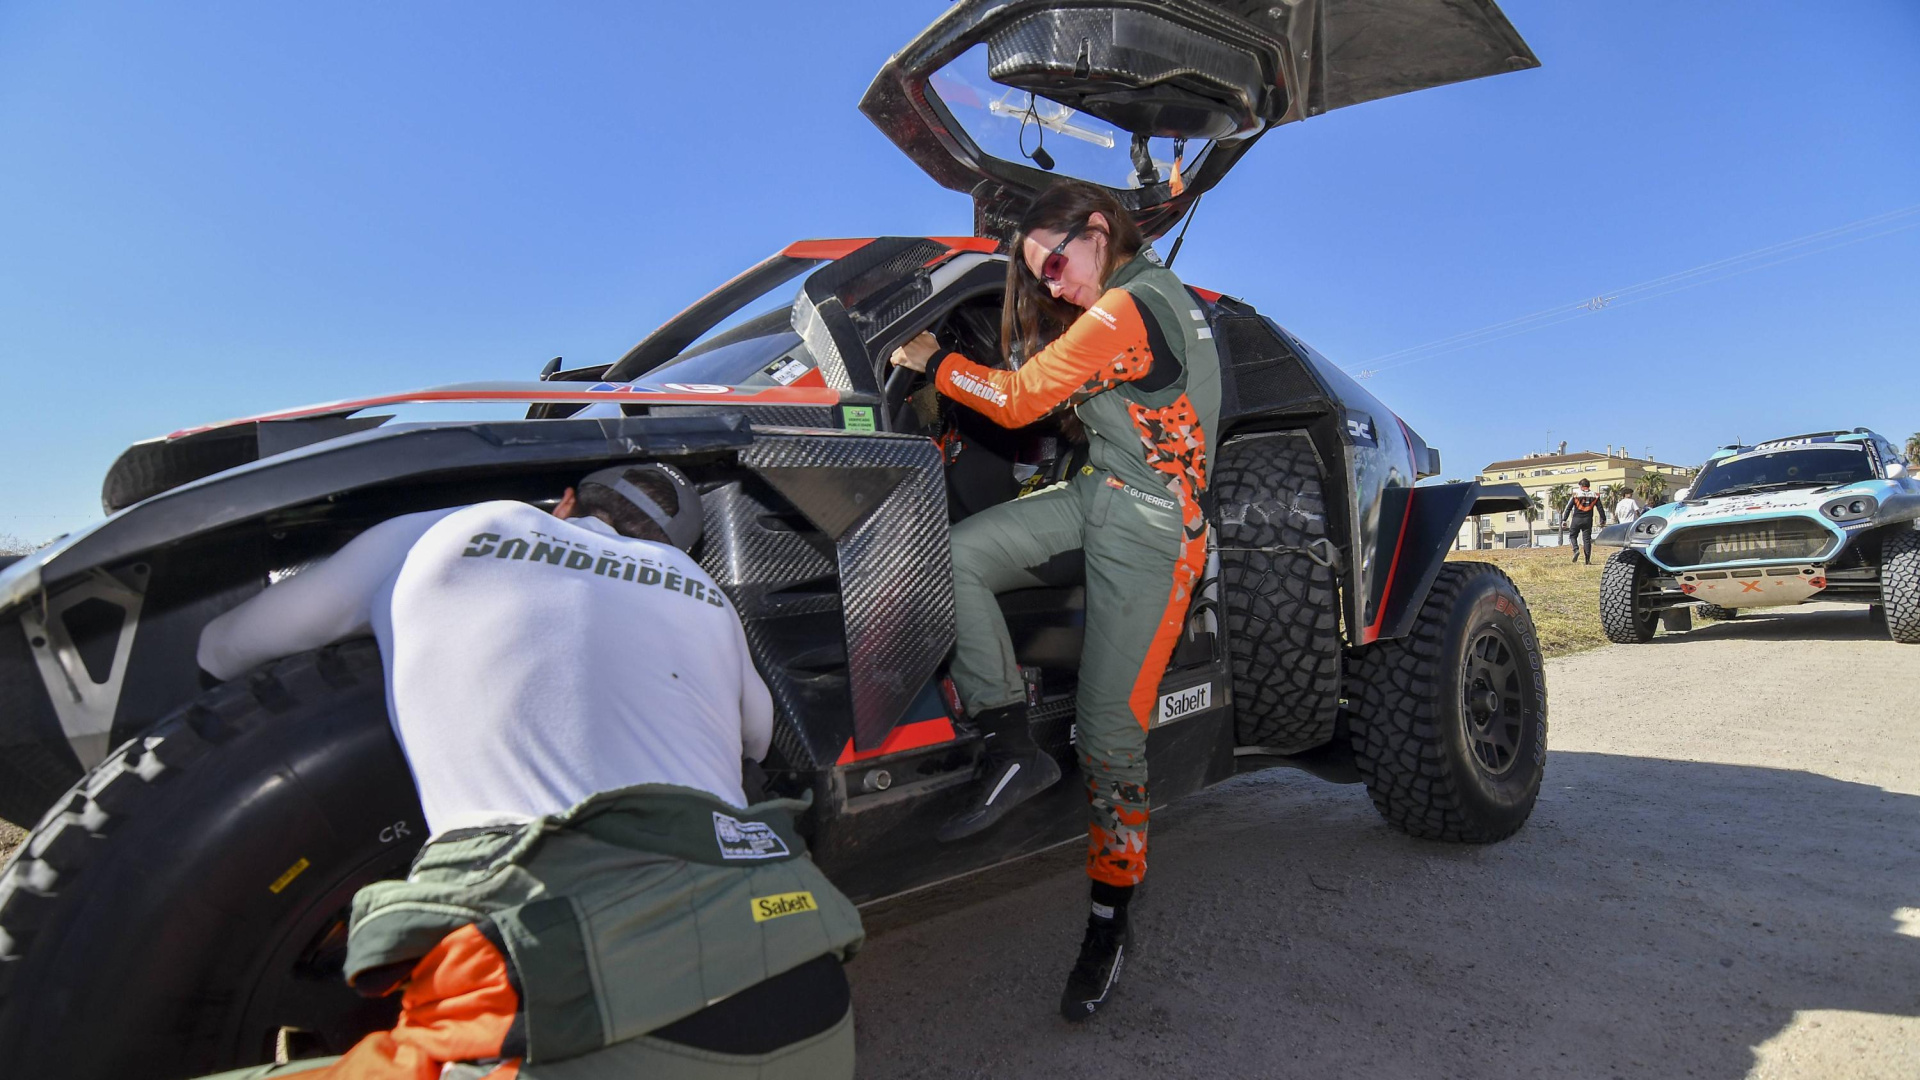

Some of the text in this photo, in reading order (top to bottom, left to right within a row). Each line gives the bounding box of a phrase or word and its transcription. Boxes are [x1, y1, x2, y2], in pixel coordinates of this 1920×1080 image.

[1753, 437, 1812, 451] MINI
[656, 462, 686, 486] PABLO
[1130, 488, 1175, 510] GUTIERREZ
[529, 530, 681, 573] THE DACIA
[1715, 529, 1777, 554] MINI
[462, 532, 725, 608] SANDRIDERS
[1164, 687, 1206, 718] Sabelt
[378, 820, 411, 843] CR
[759, 894, 812, 918] Sabelt
